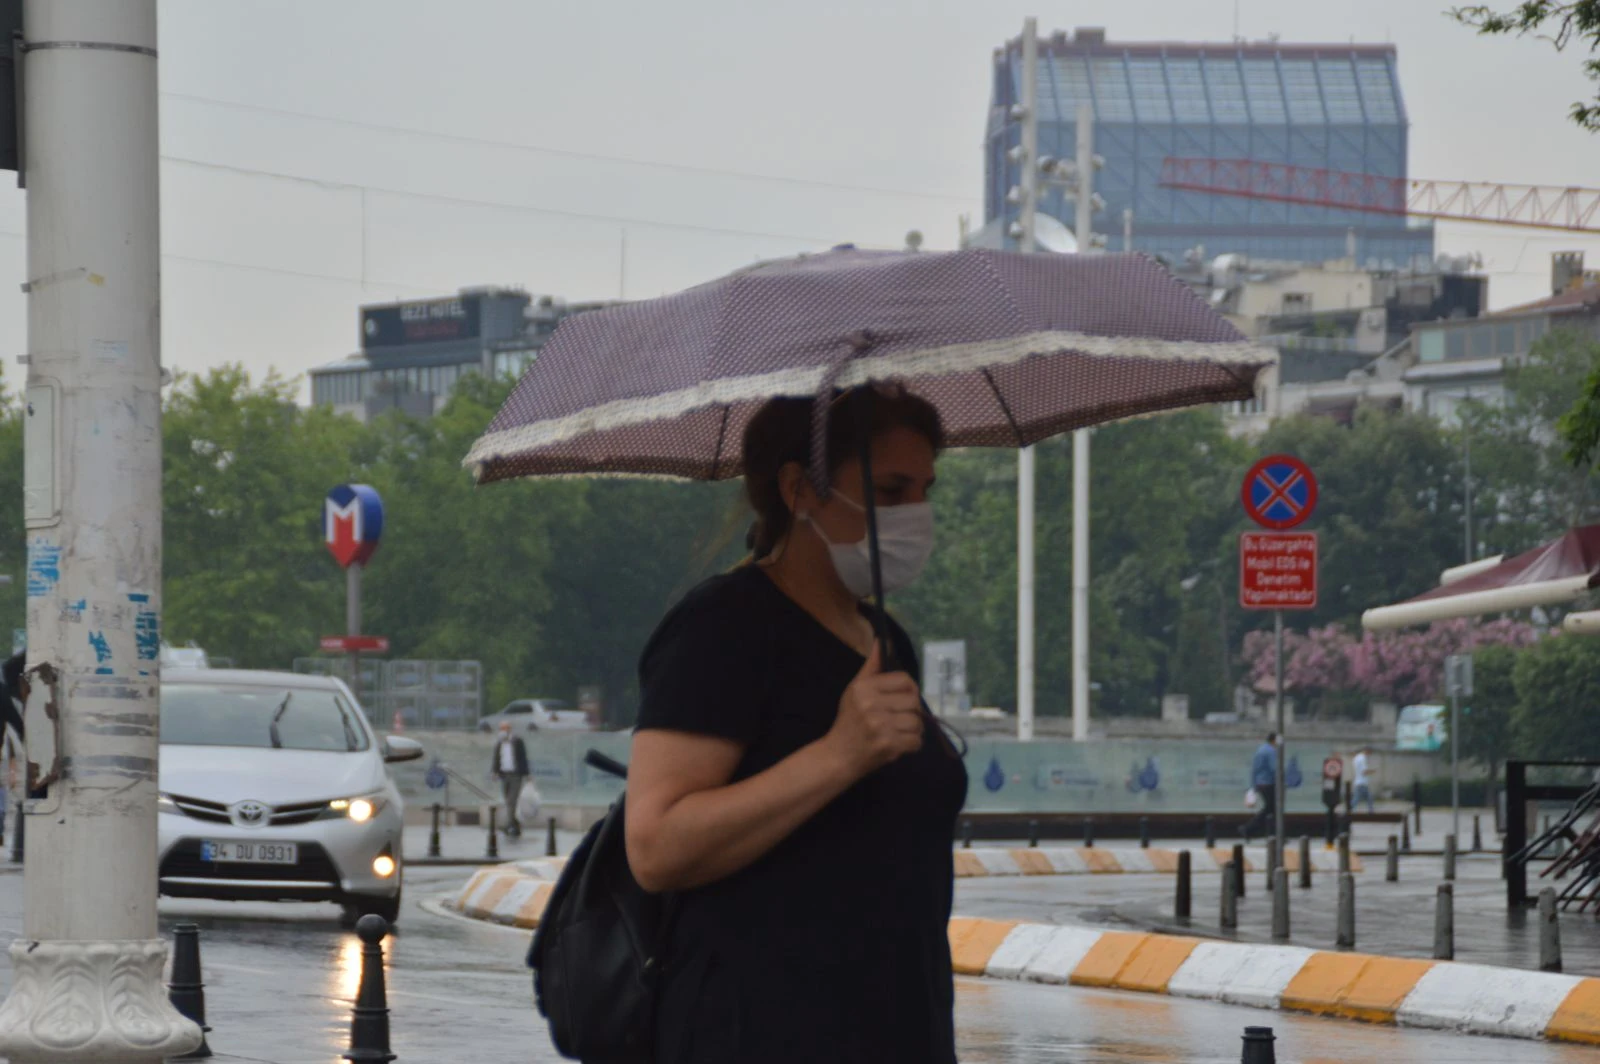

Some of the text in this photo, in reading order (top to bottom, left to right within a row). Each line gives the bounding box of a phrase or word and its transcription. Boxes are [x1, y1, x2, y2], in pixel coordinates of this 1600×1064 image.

[326, 497, 363, 544] M
[210, 843, 228, 858] 34
[258, 845, 293, 861] 0931
